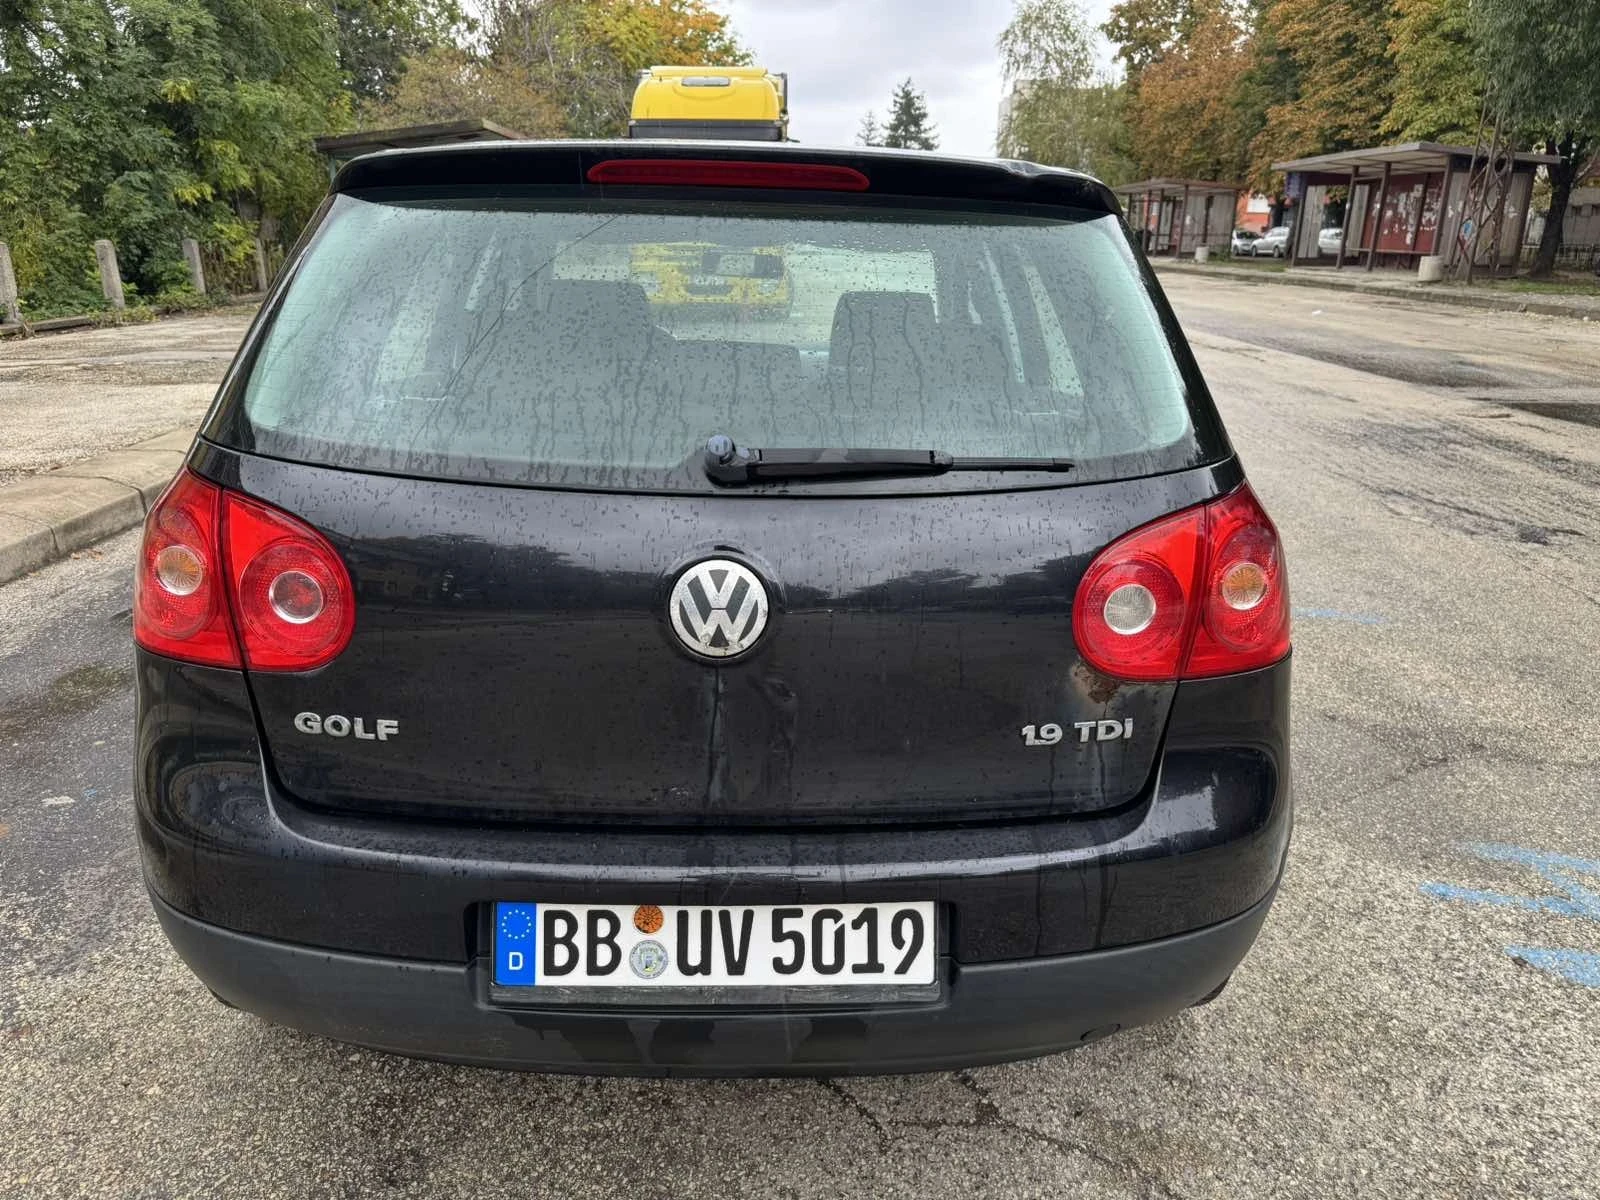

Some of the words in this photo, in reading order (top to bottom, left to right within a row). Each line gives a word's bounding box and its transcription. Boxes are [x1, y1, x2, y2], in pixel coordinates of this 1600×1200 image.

[669, 559, 769, 657] VW
[293, 711, 400, 741] GOLF
[1073, 718, 1134, 743] TDI
[543, 909, 622, 976] BB
[676, 909, 755, 976] UV
[771, 907, 925, 975] 5019
[508, 951, 524, 971] D
